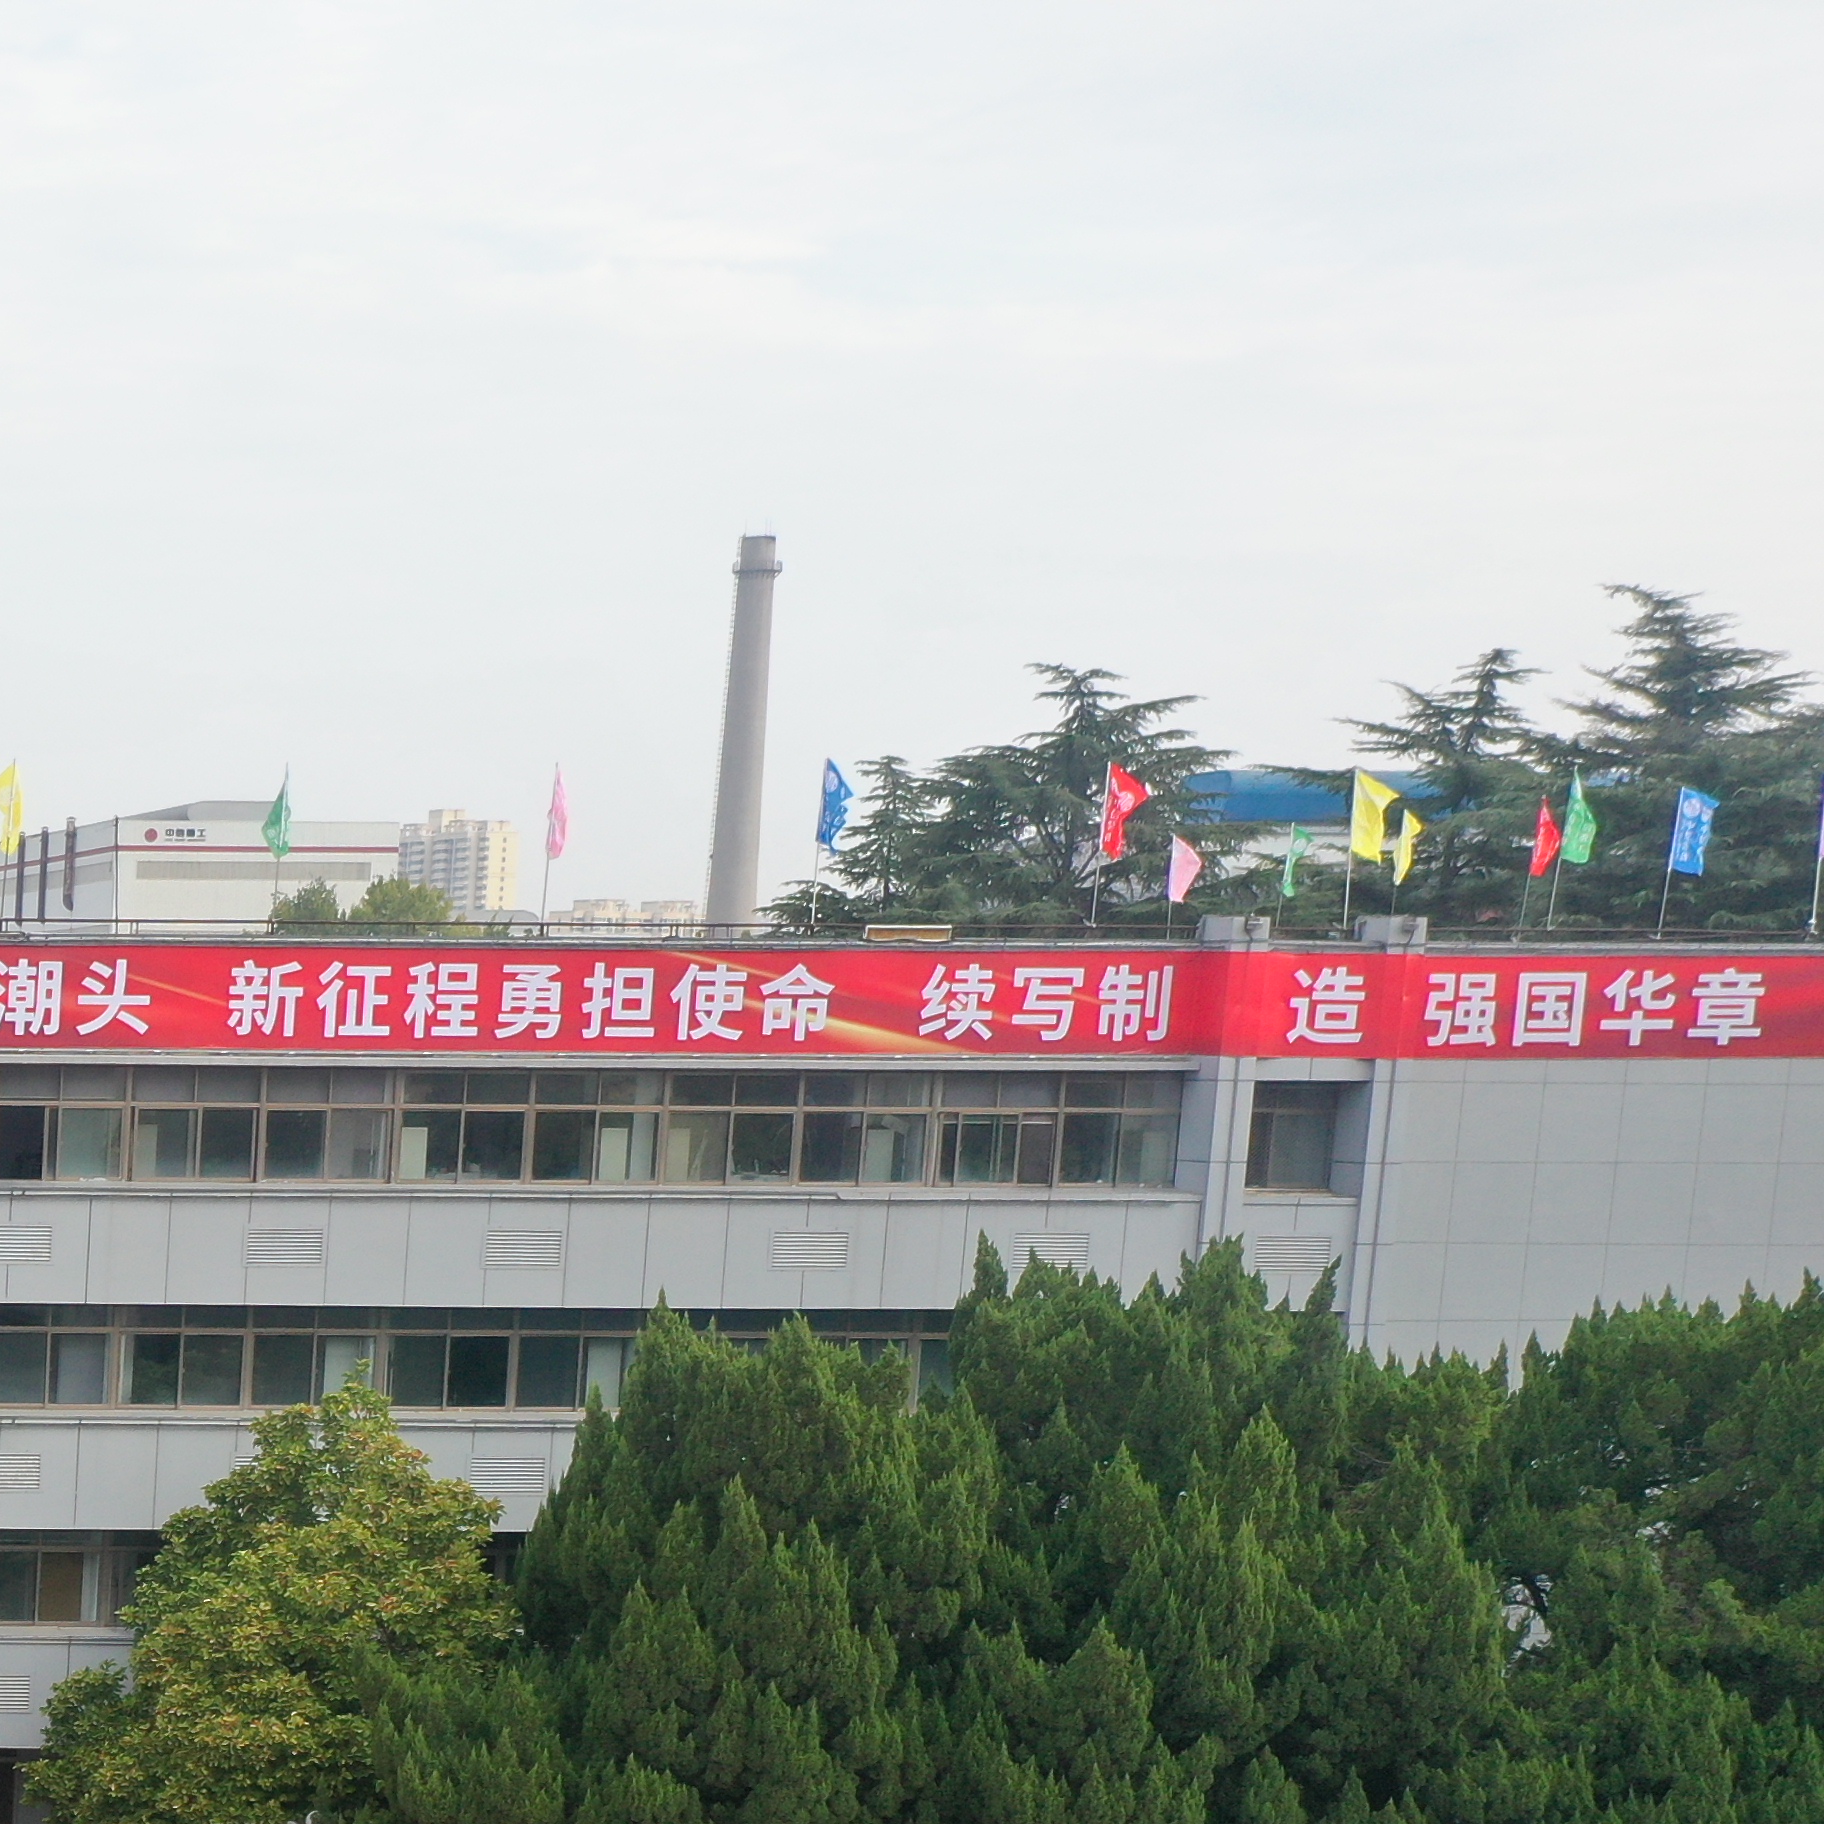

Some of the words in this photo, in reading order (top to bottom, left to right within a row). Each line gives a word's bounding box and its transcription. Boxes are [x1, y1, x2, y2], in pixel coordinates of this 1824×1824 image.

[227, 959, 836, 1041] 新征程勇担使命
